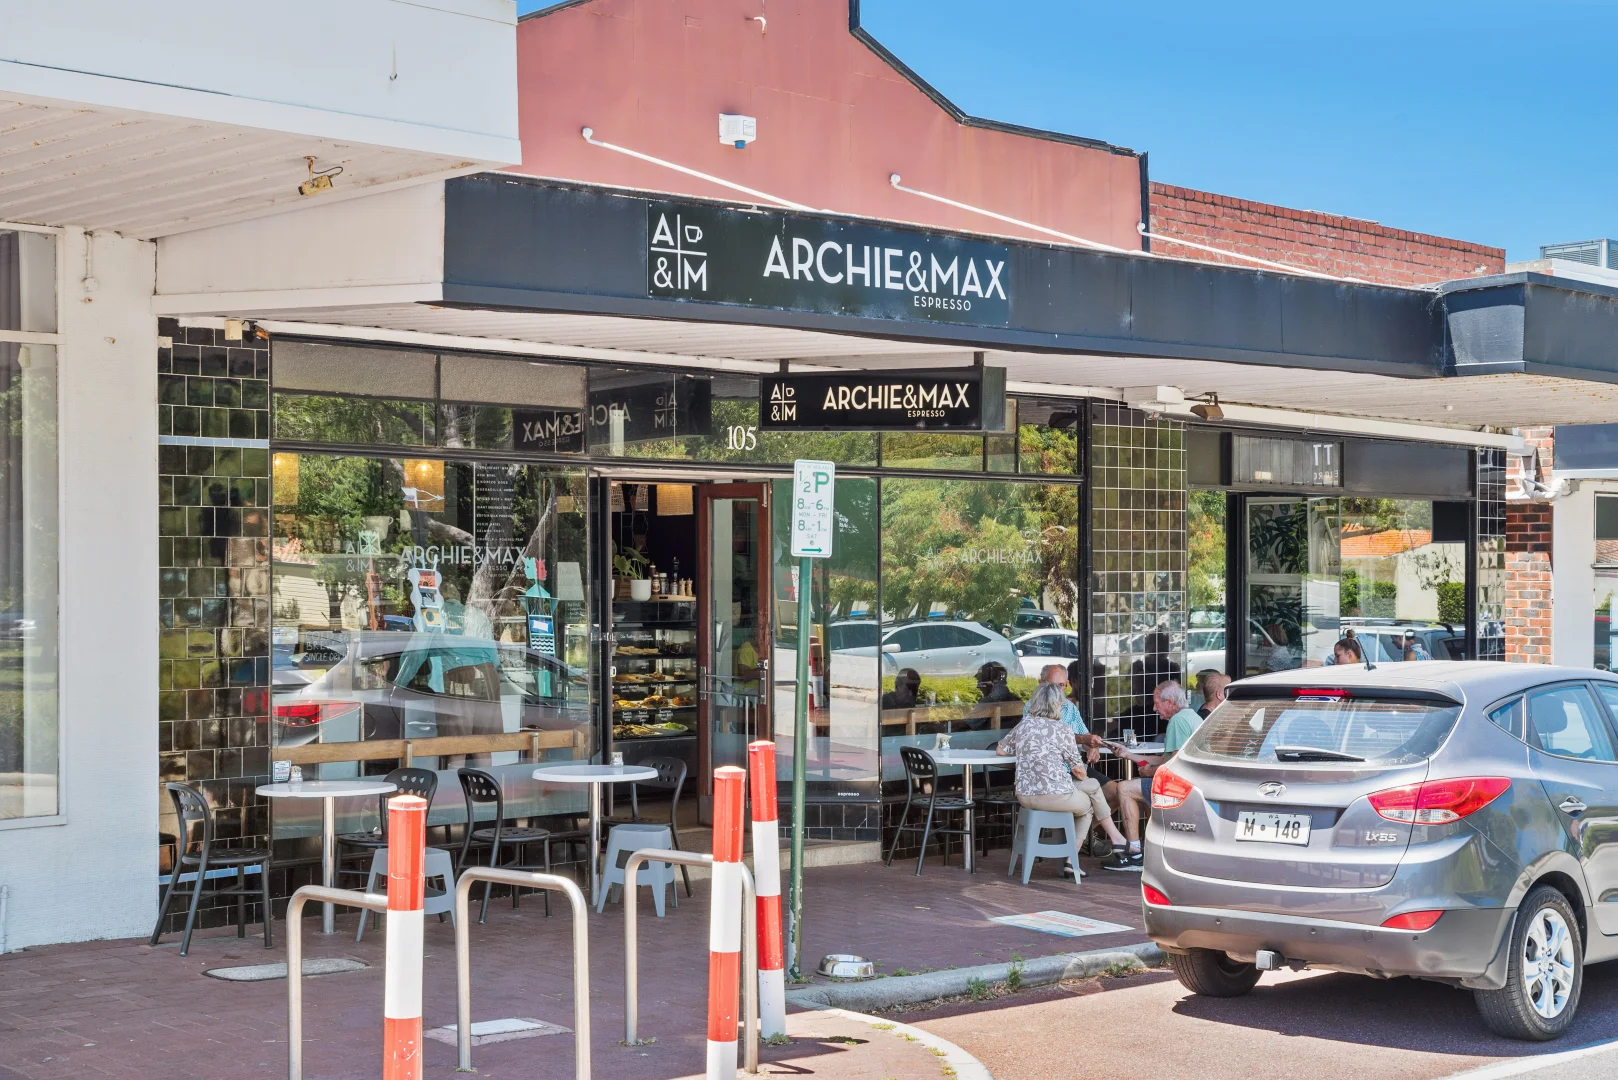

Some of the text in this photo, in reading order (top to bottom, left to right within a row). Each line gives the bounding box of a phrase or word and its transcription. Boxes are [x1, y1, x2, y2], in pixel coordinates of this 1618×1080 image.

[763, 234, 1007, 300] ARCHIE&MAX
[913, 295, 972, 311] ESPRESSO
[822, 383, 970, 410] ARCHIE&MAX
[907, 409, 945, 418] ESPRESSO
[727, 425, 757, 450] 105
[815, 471, 830, 493] P
[401, 545, 526, 565] ARCHIE&MAX
[1274, 819, 1301, 839] 148
